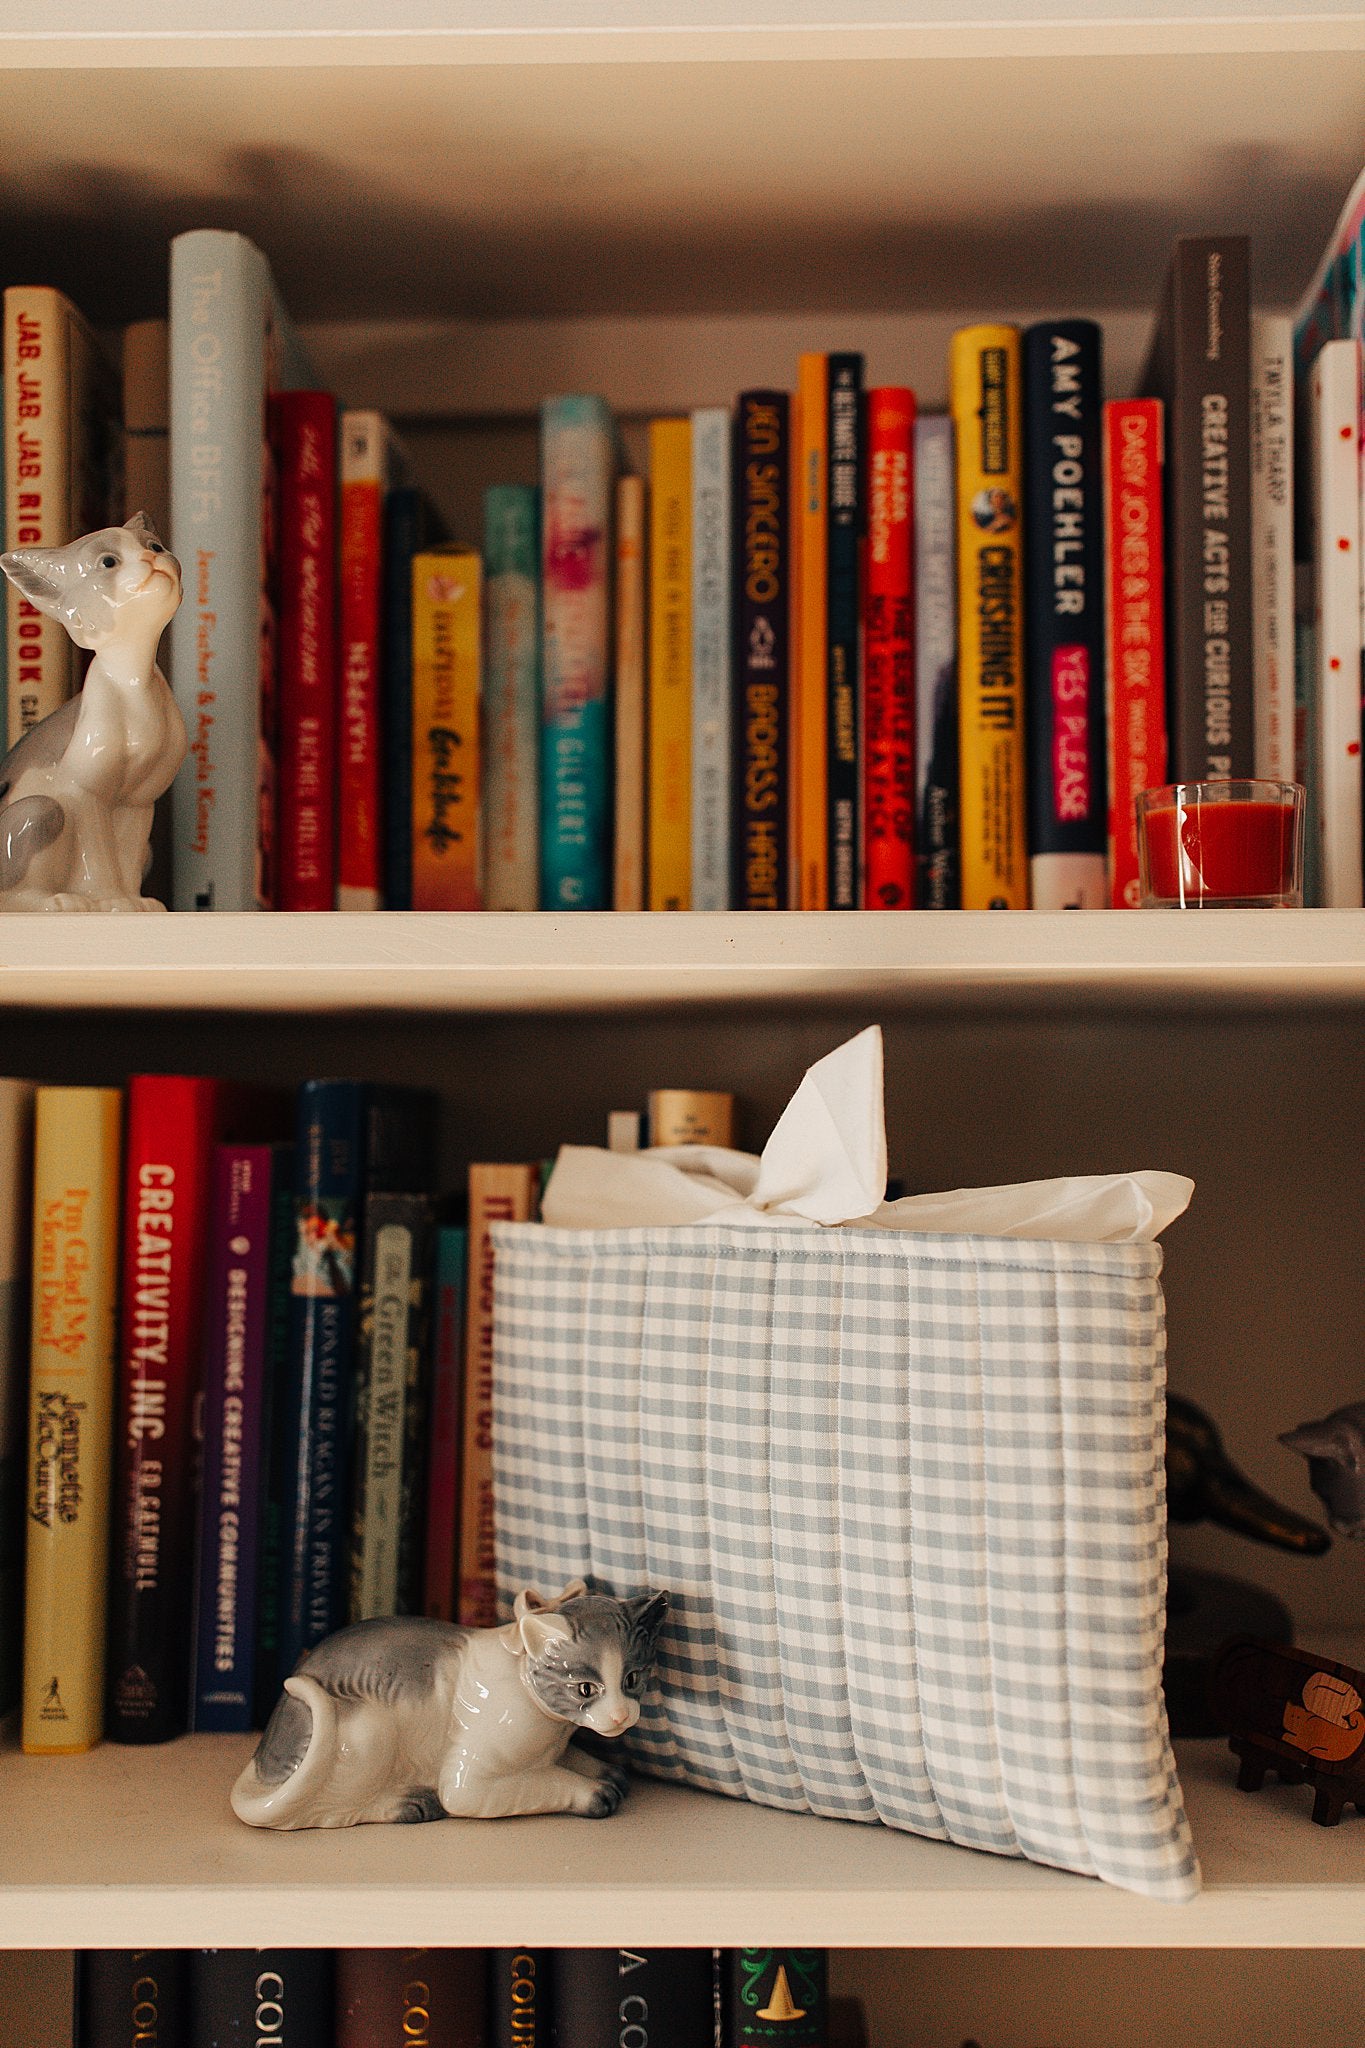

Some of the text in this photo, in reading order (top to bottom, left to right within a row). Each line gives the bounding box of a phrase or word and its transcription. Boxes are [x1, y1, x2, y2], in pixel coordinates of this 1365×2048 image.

[15, 313, 42, 367] JAB,
[192, 268, 222, 325] The
[15, 371, 42, 427] JAB,
[191, 332, 222, 435] Office
[1264, 356, 1286, 506] TWYLA THARP
[15, 431, 42, 487] JAB,
[745, 402, 779, 603] JEN SINCERO
[1051, 335, 1085, 615] AMY POEHLER
[1120, 414, 1149, 488] DAISY
[1202, 394, 1228, 519] CREATIVE
[18, 493, 42, 544] RIG
[1120, 488, 1150, 574] JONES
[1203, 529, 1229, 594] ACTS
[979, 546, 1015, 687] CRUSHING
[1121, 601, 1150, 644] THE
[1122, 648, 1151, 688] SIX
[191, 550, 216, 855] Jenna Fischer & Angela Kinsey
[980, 696, 1015, 731] IT!
[1057, 650, 1088, 821] YES PLEASE
[1205, 639, 1231, 747] CURIOUS
[556, 737, 586, 844] GILBERT
[745, 684, 778, 811] BADASS
[64, 1239, 90, 1306] Glad
[126, 1163, 175, 1449] CREATIVITY, INC.
[223, 1268, 248, 1392] DESIGNING
[377, 1294, 404, 1385] Green
[30, 1391, 62, 1529] McCurdy
[58, 1397, 87, 1524] Jennette
[220, 1397, 244, 1506] CREATIVE
[308, 1304, 341, 1637] RONALD REAGAN IN PRIVATE
[373, 1390, 402, 1480] Witch
[135, 1459, 162, 1592] ED CATMULL
[214, 1511, 239, 1672] COMMUNITIES
[618, 1949, 648, 1977] A
